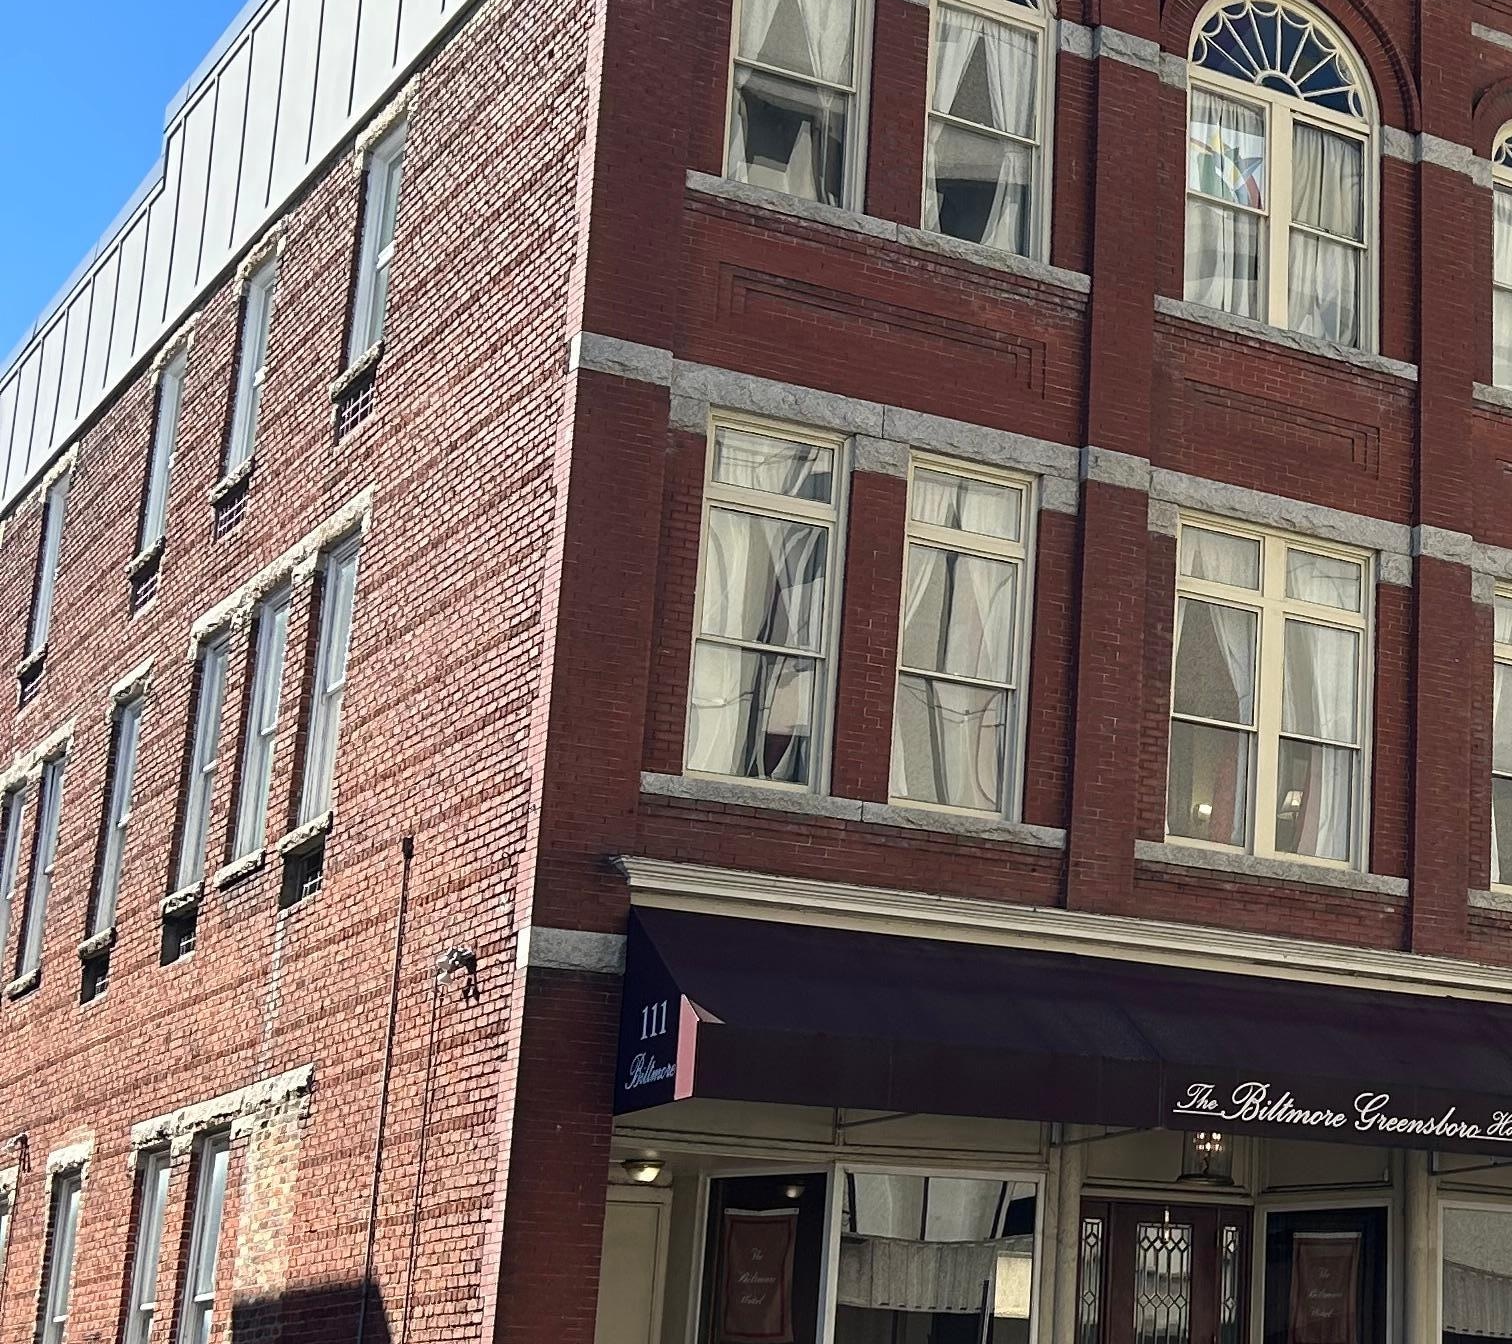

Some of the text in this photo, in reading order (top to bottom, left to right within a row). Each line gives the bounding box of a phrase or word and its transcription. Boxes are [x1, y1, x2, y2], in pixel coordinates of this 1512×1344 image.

[640, 1000, 668, 1040] 111
[624, 1052, 677, 1090] Biltmore
[1177, 1083, 1219, 1110] The
[1221, 1082, 1347, 1127] Biltmore
[1354, 1092, 1482, 1138] Greensboro
